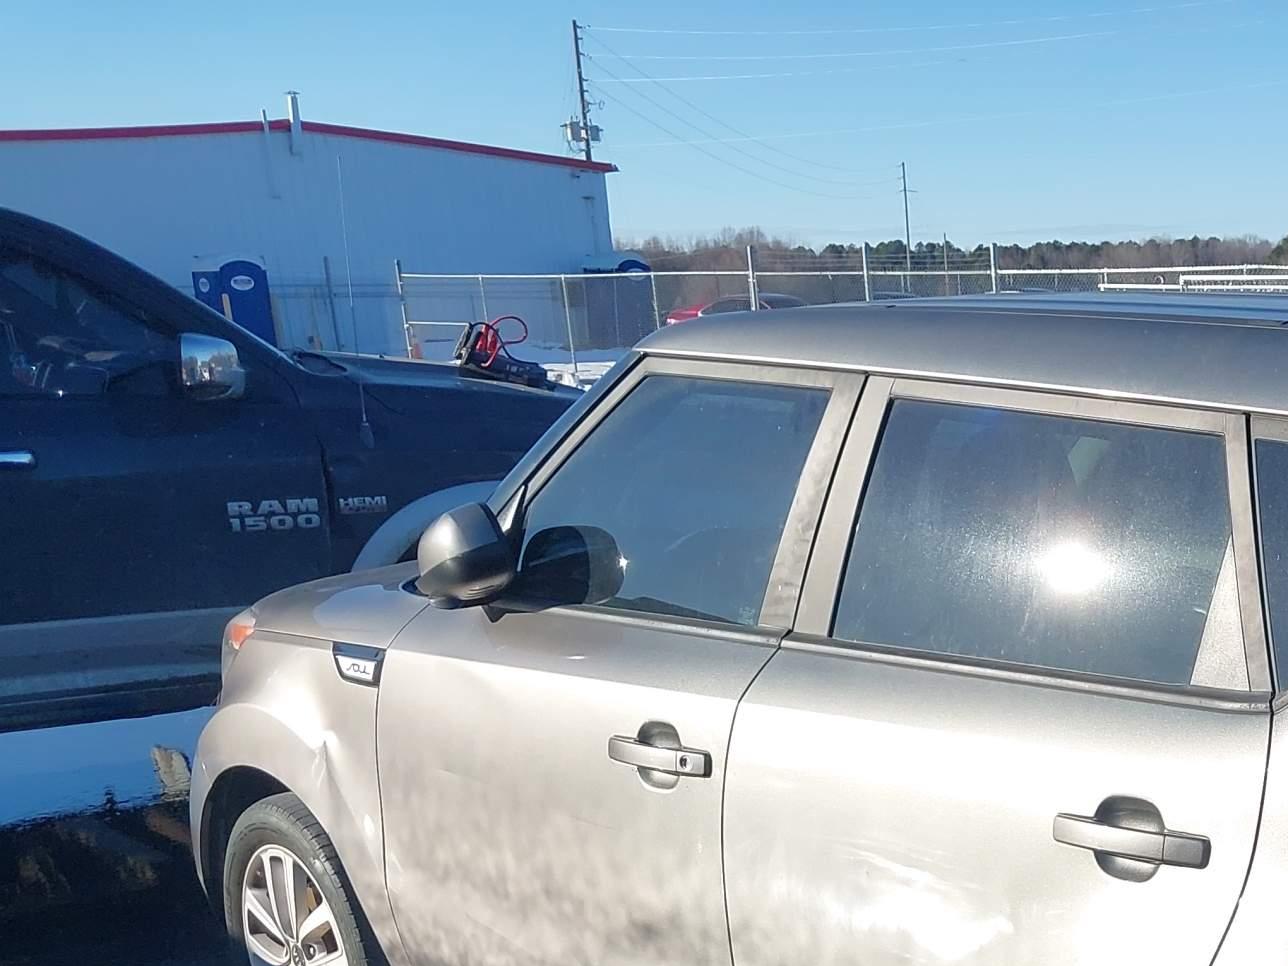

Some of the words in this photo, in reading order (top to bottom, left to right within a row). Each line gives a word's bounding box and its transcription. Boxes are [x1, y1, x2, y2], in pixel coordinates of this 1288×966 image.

[227, 498, 319, 516] RAM
[339, 495, 387, 508] HEMI
[229, 513, 320, 532] 1500
